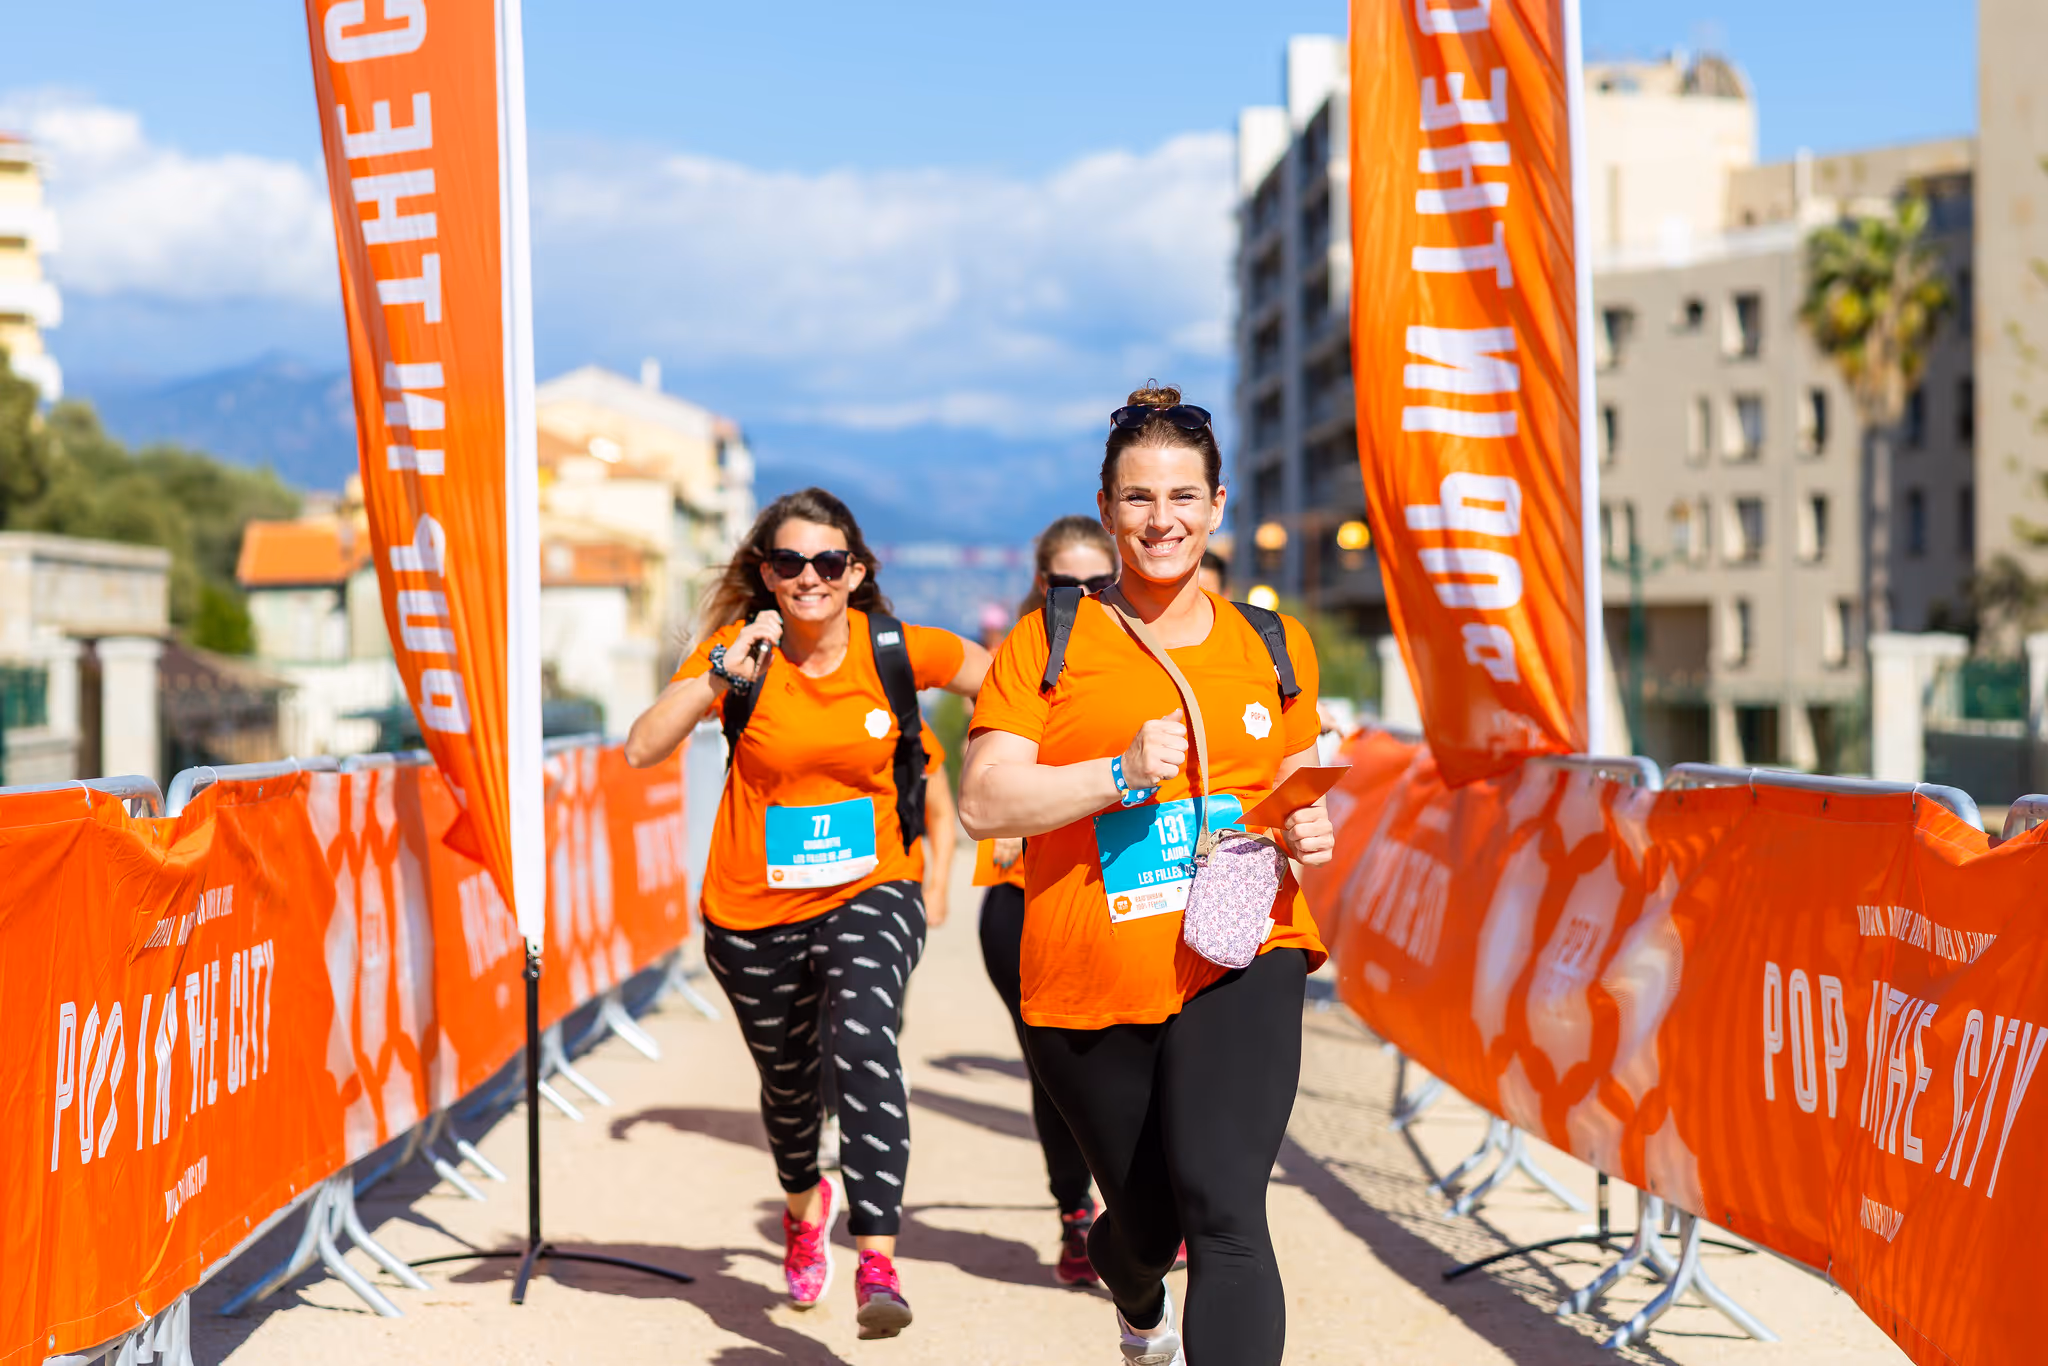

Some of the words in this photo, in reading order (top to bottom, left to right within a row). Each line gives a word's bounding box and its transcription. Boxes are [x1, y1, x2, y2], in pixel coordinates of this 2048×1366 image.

[812, 814, 831, 838] 77
[1154, 813, 1188, 846] 131
[1161, 845, 1191, 862] LAURA
[1138, 870, 1155, 885] LES
[1155, 866, 1184, 882] FILLES
[1763, 960, 1849, 1119] POP
